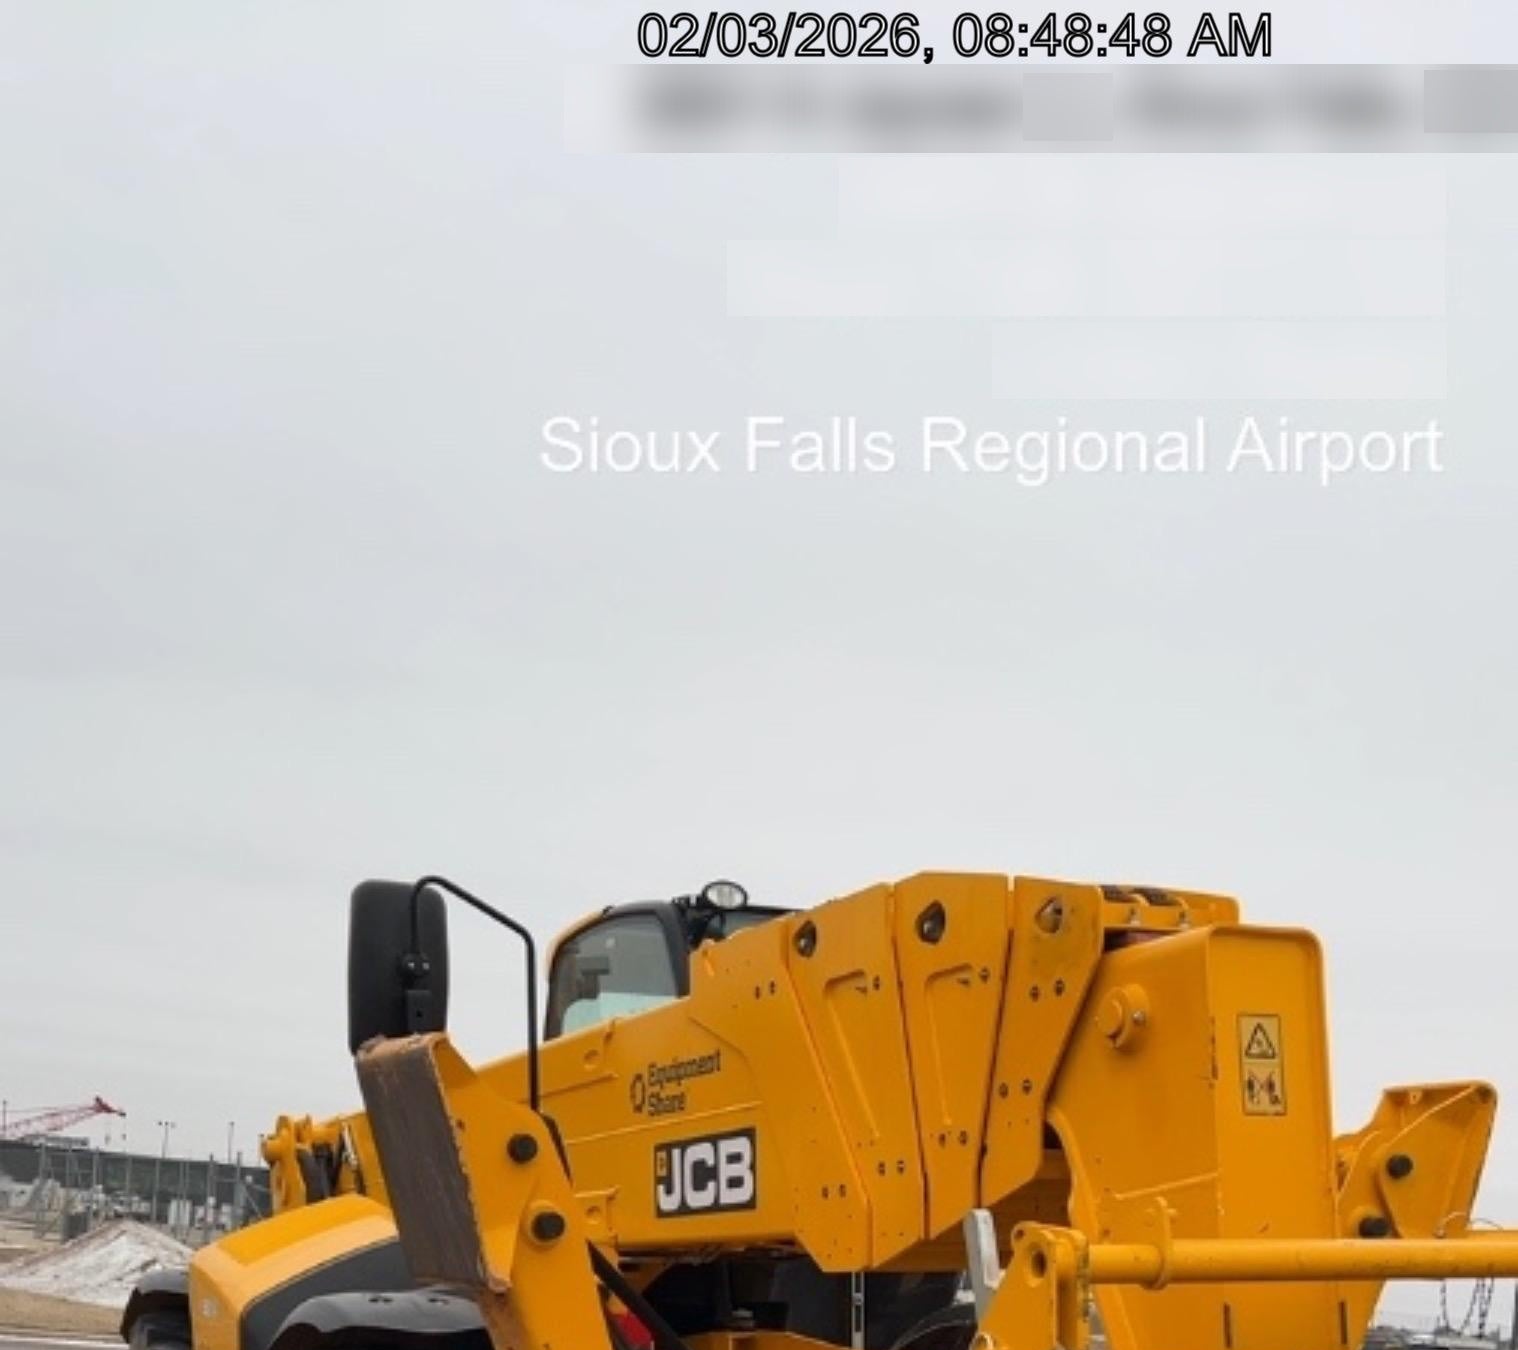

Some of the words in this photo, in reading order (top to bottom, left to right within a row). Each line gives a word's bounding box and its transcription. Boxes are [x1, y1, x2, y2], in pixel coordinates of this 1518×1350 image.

[648, 1050, 721, 1087] Equipment
[648, 1092, 686, 1116] Share
[656, 1136, 754, 1212] JCB
